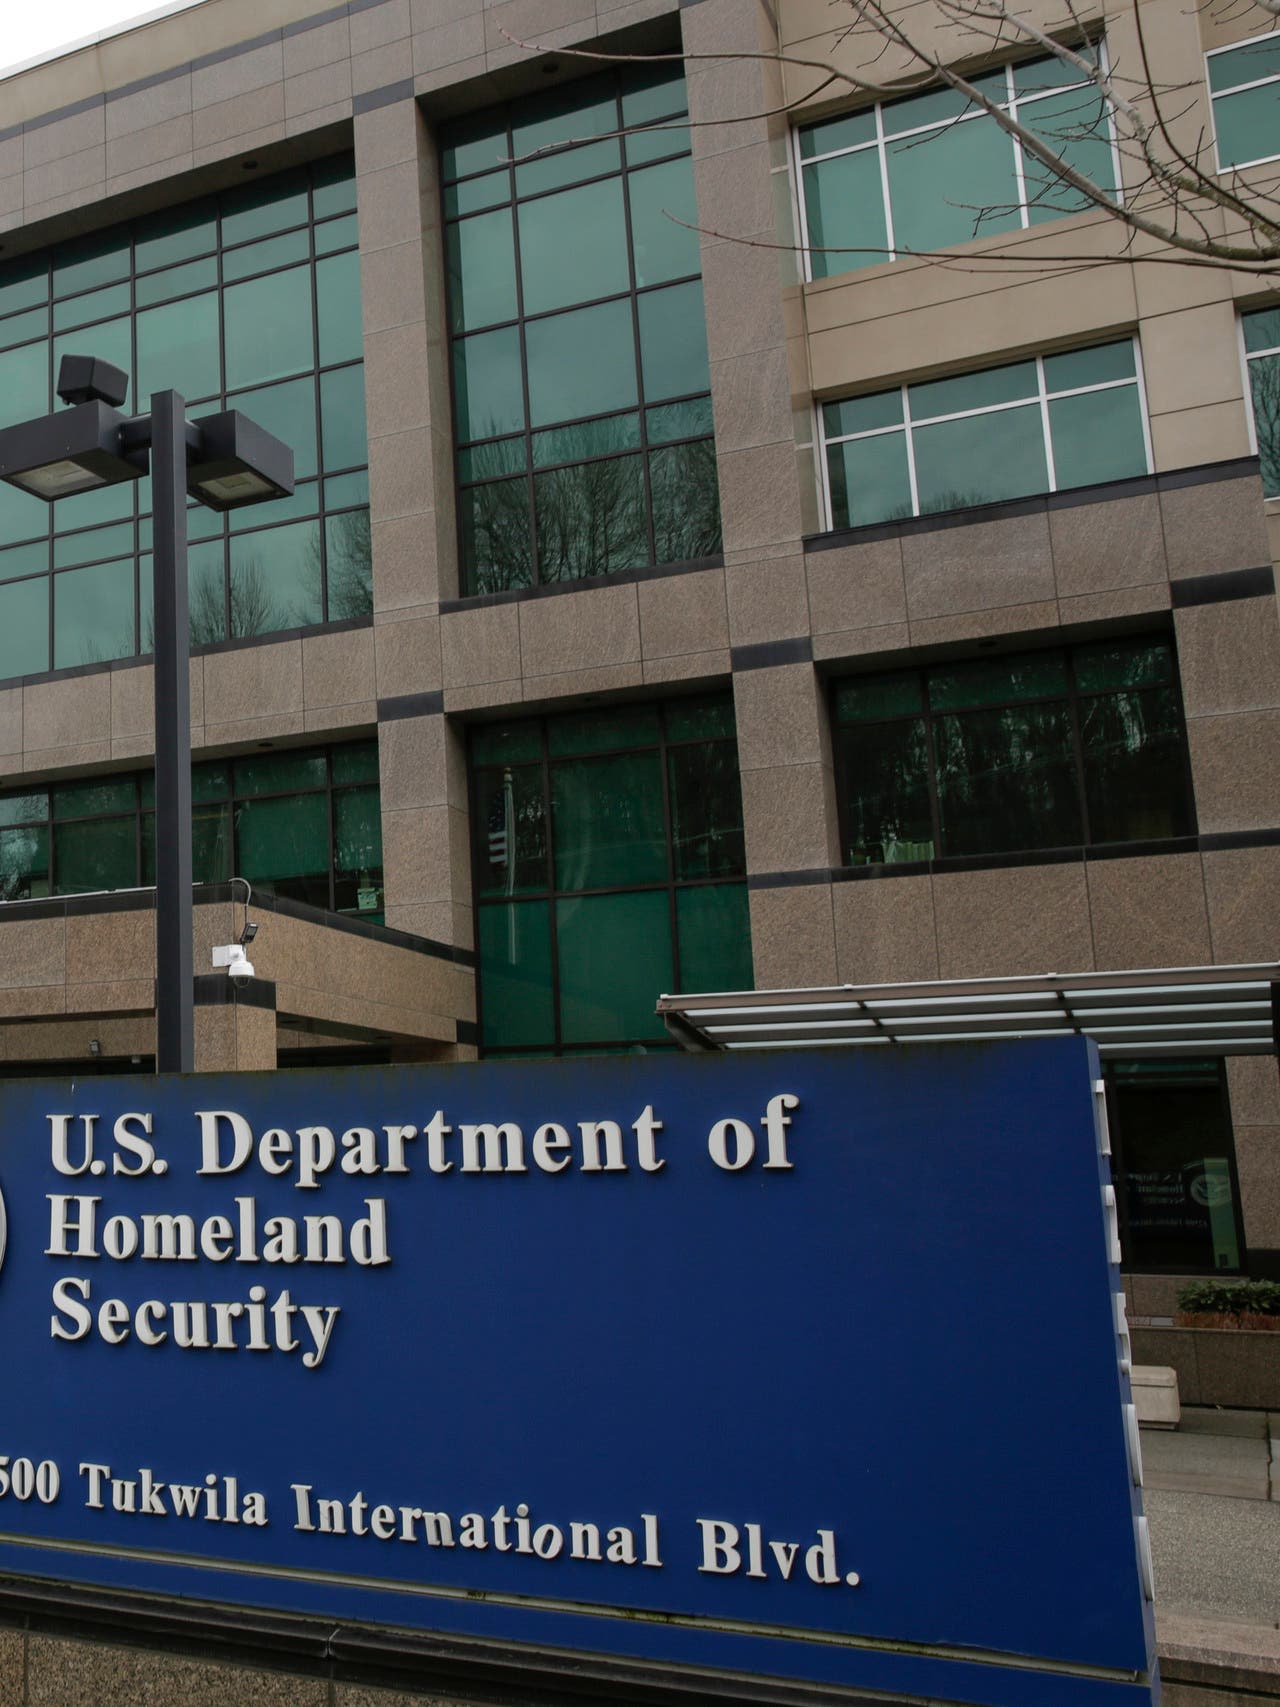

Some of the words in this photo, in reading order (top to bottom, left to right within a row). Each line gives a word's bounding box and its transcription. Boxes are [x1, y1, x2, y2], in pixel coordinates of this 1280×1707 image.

[46, 1111, 168, 1176] U.S.
[195, 1104, 666, 1188] Department
[707, 1094, 799, 1170] of
[44, 1194, 392, 1268] Homeland
[50, 1276, 341, 1368] Security
[78, 1462, 268, 1527] Tukwila
[290, 1483, 663, 1568] International
[696, 1518, 861, 1587] Blvd.
